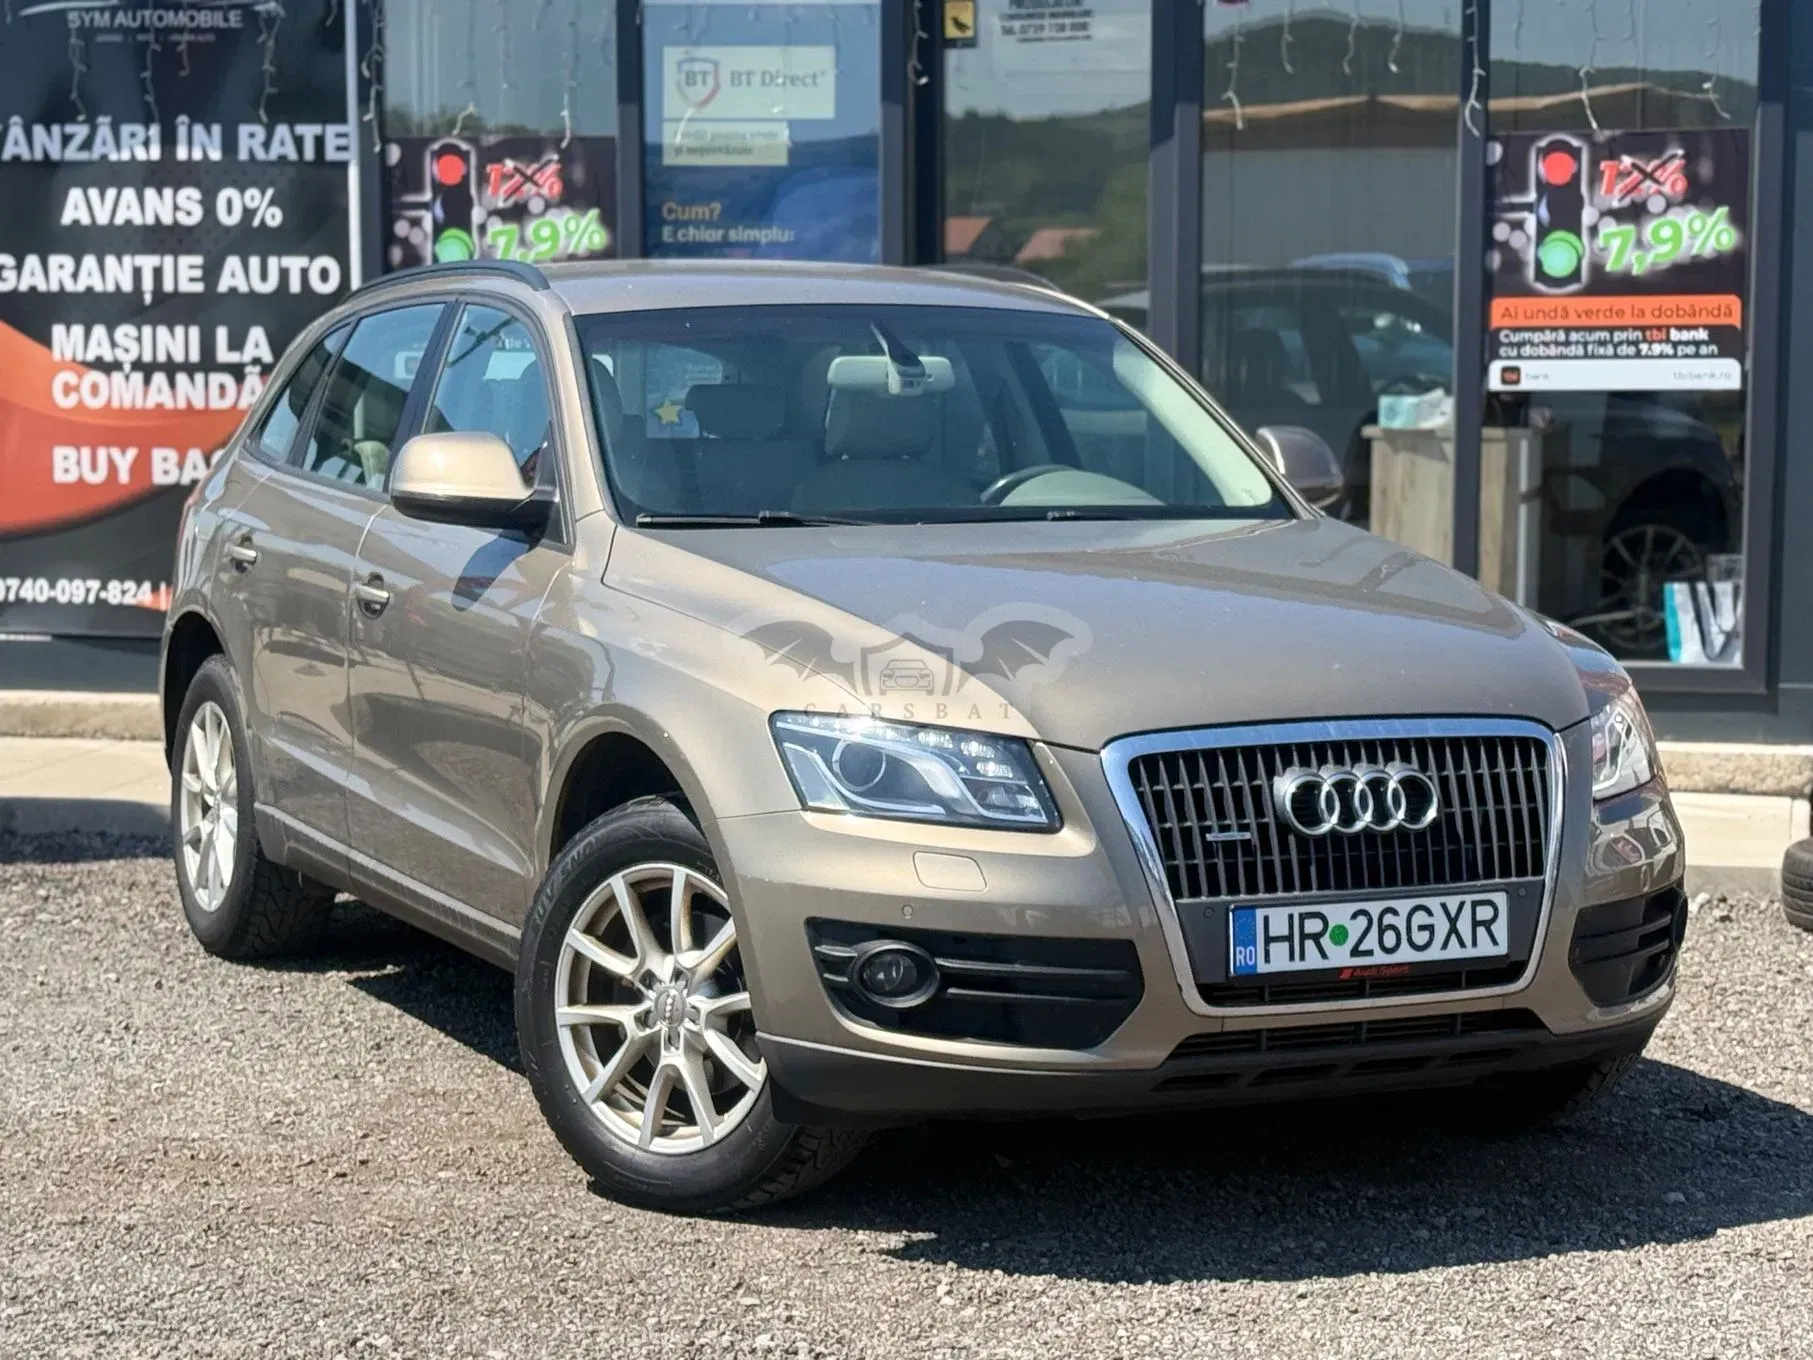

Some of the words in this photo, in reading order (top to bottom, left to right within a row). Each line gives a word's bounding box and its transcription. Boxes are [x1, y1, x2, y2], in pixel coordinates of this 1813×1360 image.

[66, 9, 110, 28] SYM
[112, 9, 244, 28] AUTOMOBILE
[684, 70, 711, 88] BT
[729, 70, 755, 88] BT
[176, 115, 222, 162] ÎN
[238, 124, 350, 162] RATE
[60, 187, 204, 226] AVANS
[216, 188, 283, 228] 0%
[662, 202, 722, 220] Cum?
[662, 226, 674, 243] E
[676, 224, 725, 243] chiar
[1599, 206, 1736, 275] 7,9%
[217, 256, 341, 295] AUTO
[1501, 306, 1518, 320] Ai
[1574, 304, 1626, 320] verde
[1631, 303, 1645, 319] la
[215, 326, 274, 363] LA
[1569, 330, 1611, 343] acum
[1613, 328, 1643, 343] prin
[1669, 327, 1710, 342] bank
[1499, 345, 1518, 357] cu
[1616, 343, 1637, 356] de
[1638, 342, 1675, 357] 7.9%
[1677, 344, 1697, 357] pe
[1698, 344, 1719, 356] an
[53, 446, 138, 484] BUY
[1262, 911, 1330, 965] HR
[1348, 898, 1500, 958] 26GXR
[1235, 945, 1256, 967] RO
